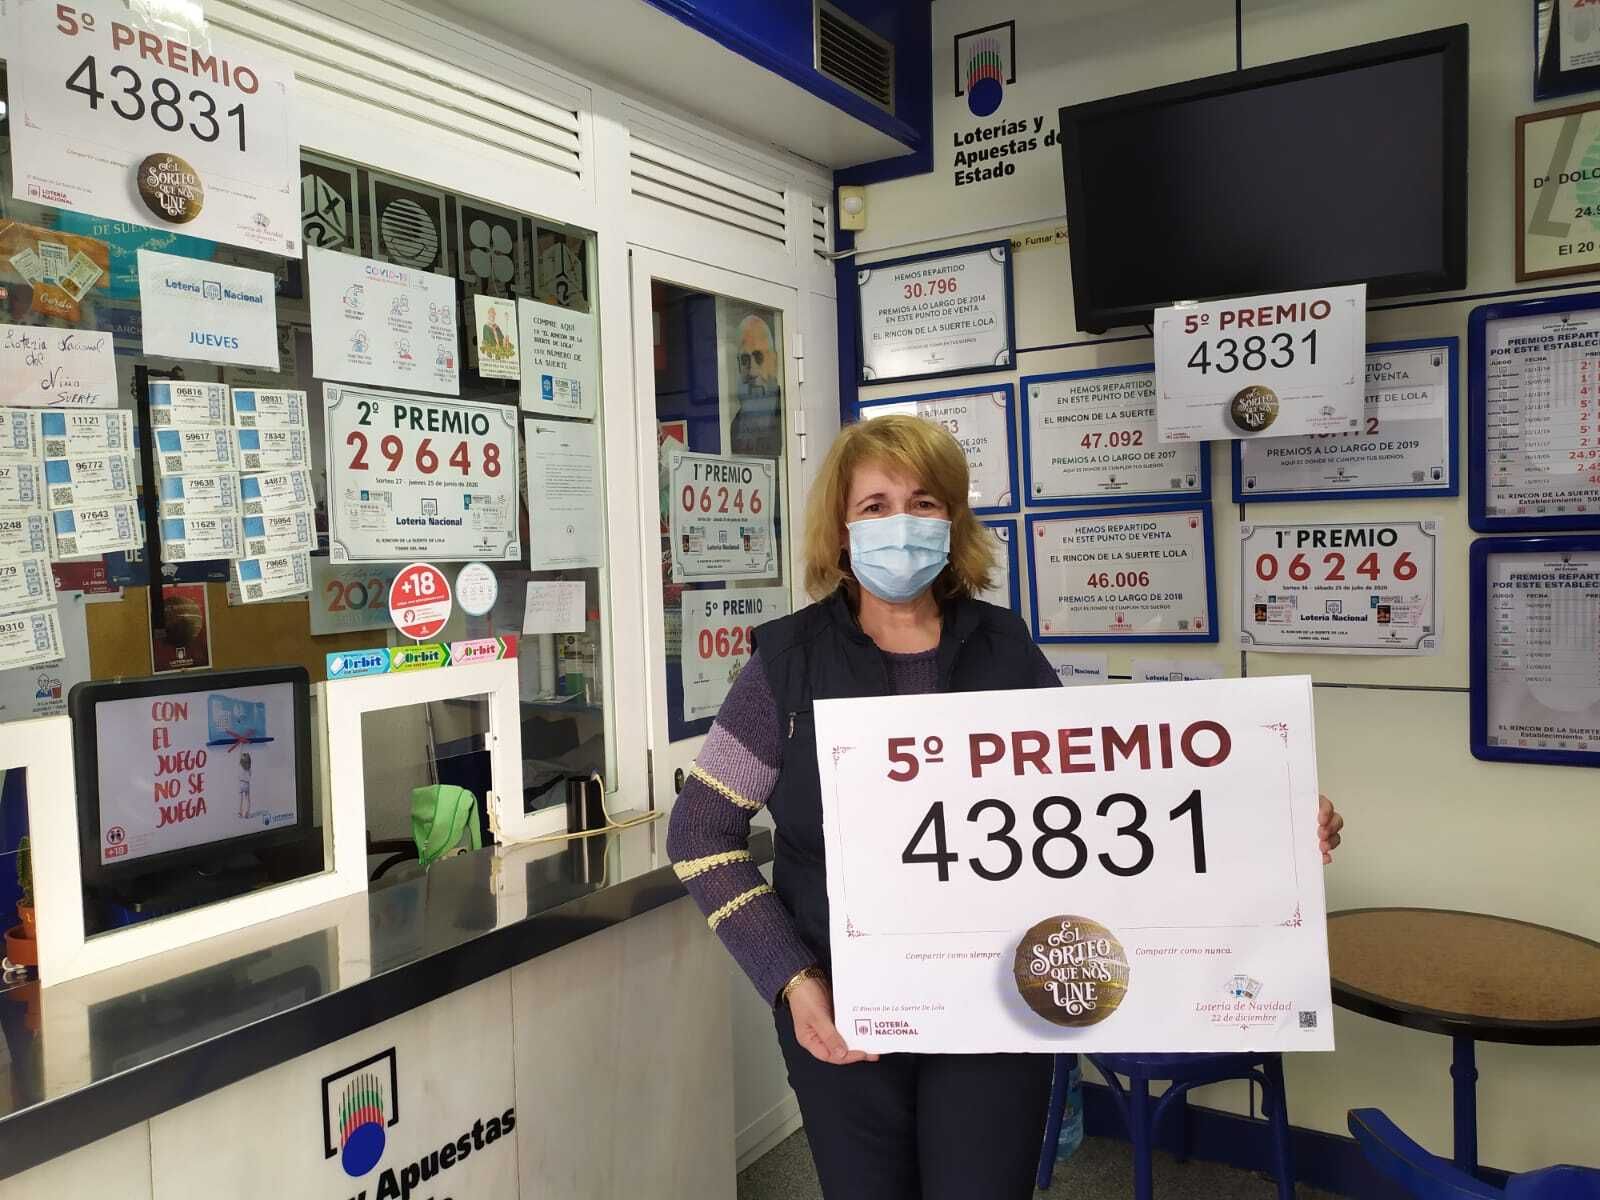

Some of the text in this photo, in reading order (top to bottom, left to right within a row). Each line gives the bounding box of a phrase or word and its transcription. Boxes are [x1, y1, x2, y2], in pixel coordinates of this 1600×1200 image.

[56, 4, 259, 94] 5º PREMIO
[66, 55, 246, 152] 43831
[954, 116, 1044, 147] Loterías y
[954, 137, 1037, 168] Apuestas
[955, 162, 1016, 186] Estado
[1026, 234, 1052, 246] Fumar
[1578, 241, 1594, 253] 20
[894, 264, 965, 282] HEMOS REPARTIDO
[224, 289, 263, 304] Nacional
[904, 277, 957, 299] 30.796
[879, 299, 956, 316] PREMIOS LARGO
[898, 305, 979, 322] ESTE PUNTO VENTA
[940, 317, 994, 331] SUERTE LOLA
[1184, 300, 1331, 334] 5º PREMIO
[189, 332, 239, 349] JUEVES
[1508, 335, 1554, 346] PREMIOS
[1187, 329, 1317, 375] 43831
[1514, 345, 1541, 354] ESTE
[1372, 372, 1409, 382] VENTA
[1070, 380, 1153, 395] HEMOS REPARTIDO
[1057, 390, 1136, 405] EN ESTE PUNTO DE
[1384, 392, 1428, 402] DE LOLA
[394, 404, 490, 436] PREMIO
[1091, 412, 1103, 420] DE
[1105, 411, 1118, 420] LA
[1119, 408, 1156, 418] SUERTE
[1081, 429, 1143, 449] 47.092
[346, 431, 501, 478] 29648
[1267, 440, 1419, 457] PREMIOS LO LARGO DE 2019
[1051, 450, 1176, 465] PREMIOS LARGO DE 2017
[705, 464, 753, 484] PREMIO
[682, 484, 762, 514] 06246
[428, 517, 462, 527] Nacional
[1075, 522, 1157, 534] HEMOS REPARTIDO
[1063, 531, 1172, 544] EN ESTE PUNTO DE VENTA
[1297, 528, 1398, 548] PREMIO
[1050, 555, 1060, 563] EL
[1097, 552, 1110, 561] DE
[1111, 552, 1123, 560] LA
[1125, 550, 1161, 559] SUERTE
[1163, 549, 1188, 558] LOLA
[1256, 552, 1418, 581] 06246
[401, 571, 436, 596] +18
[1087, 570, 1150, 588] 46.006
[1492, 581, 1513, 589] POR
[1510, 573, 1555, 581] PREMIOS
[1058, 592, 1183, 604] PREMIOS LO LARGO DE 2018
[723, 598, 763, 617] PREMIO
[1332, 614, 1368, 622] Nacional
[344, 645, 495, 669] Orbit Orbit Orbit
[152, 702, 188, 722] CON
[153, 727, 171, 750] EL
[886, 720, 1232, 782] 5º PREMIO
[155, 750, 207, 776] JUEGO
[154, 772, 205, 802] NO SE
[156, 797, 207, 828] JUEGA
[901, 789, 1208, 882] 43831
[905, 951, 946, 960] Compartir
[970, 951, 1001, 961] siempre
[1030, 938, 1111, 975] SORTEO
[1135, 946, 1178, 957] Compartir
[1180, 947, 1202, 955] como
[1051, 967, 1078, 983] QUE
[1044, 981, 1098, 1015] UNE
[1235, 1001, 1247, 1011] de
[1249, 1001, 1292, 1011] Navidad
[874, 1019, 909, 1028] LOTERÍA
[1211, 1012, 1277, 1022] 22 de diciembre
[875, 1028, 919, 1036] NACIONAL
[376, 1107, 516, 1200] Apuestas
